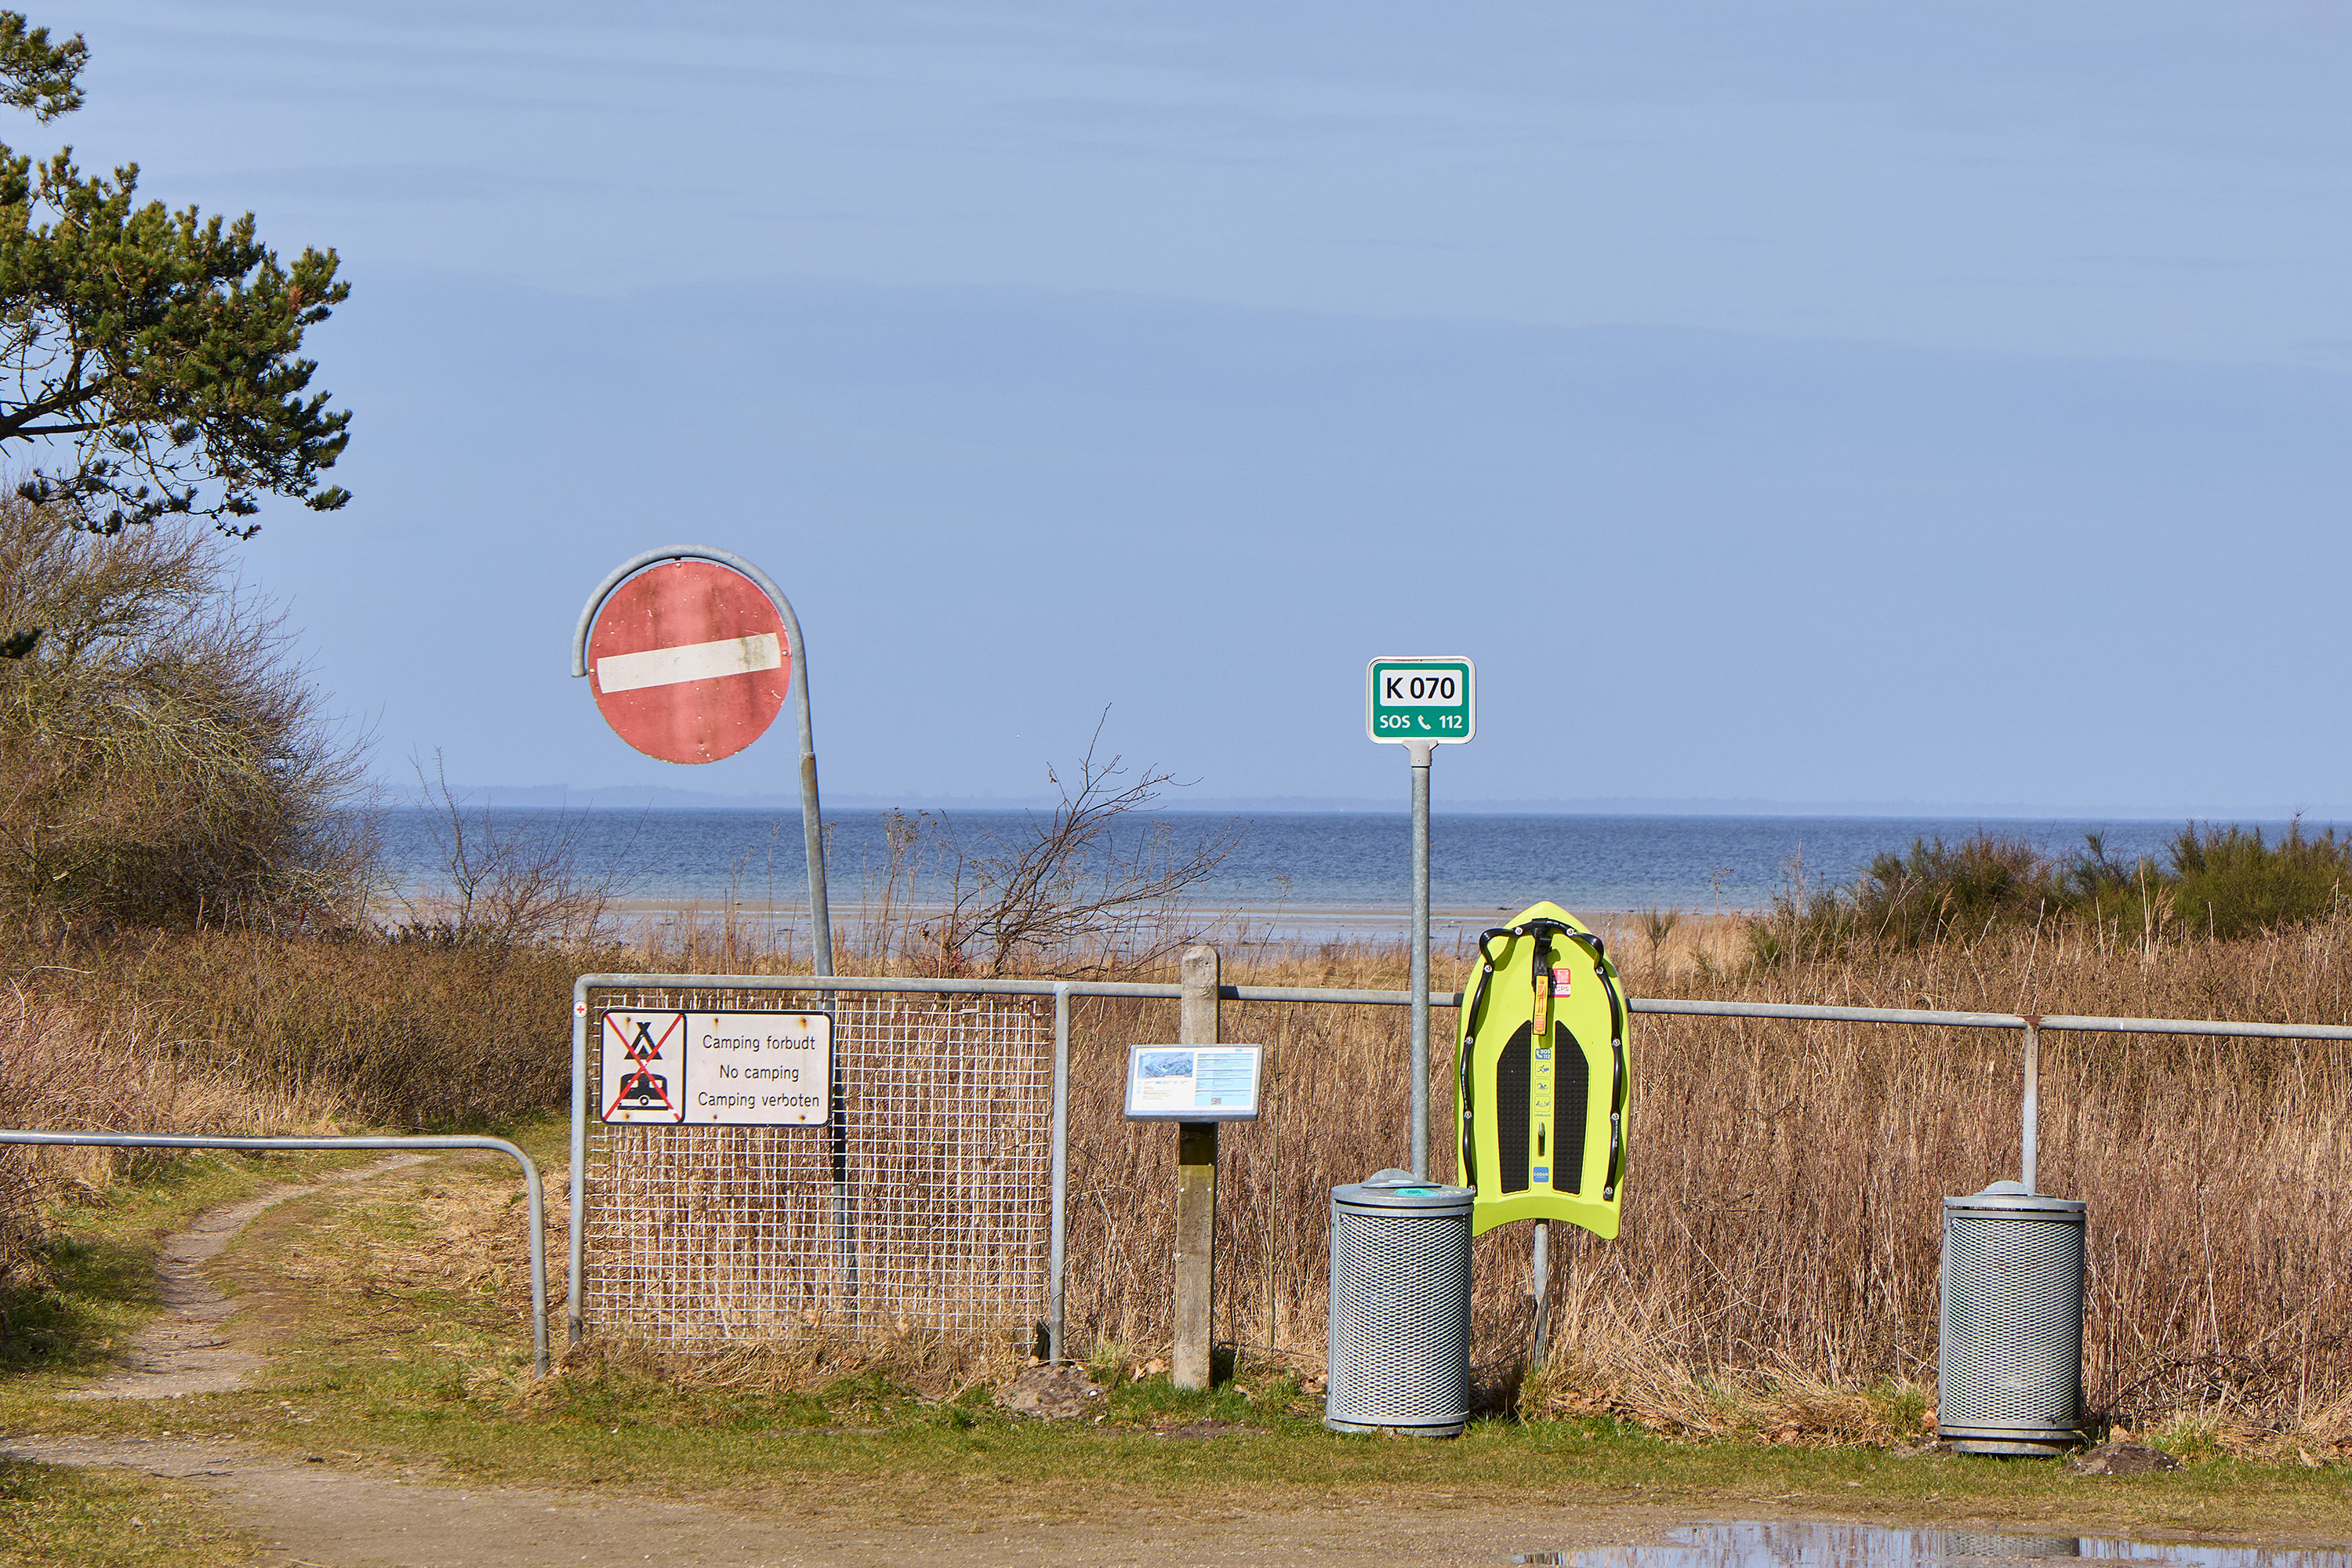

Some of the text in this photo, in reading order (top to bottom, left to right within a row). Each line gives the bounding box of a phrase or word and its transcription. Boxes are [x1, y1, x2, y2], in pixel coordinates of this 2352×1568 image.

[1386, 677, 1455, 699] K 070
[1379, 714, 1463, 728] SOS 112
[702, 1034, 816, 1052] Camping forbudt
[719, 1064, 800, 1082] No camping
[698, 1091, 820, 1109] Camping verboten
